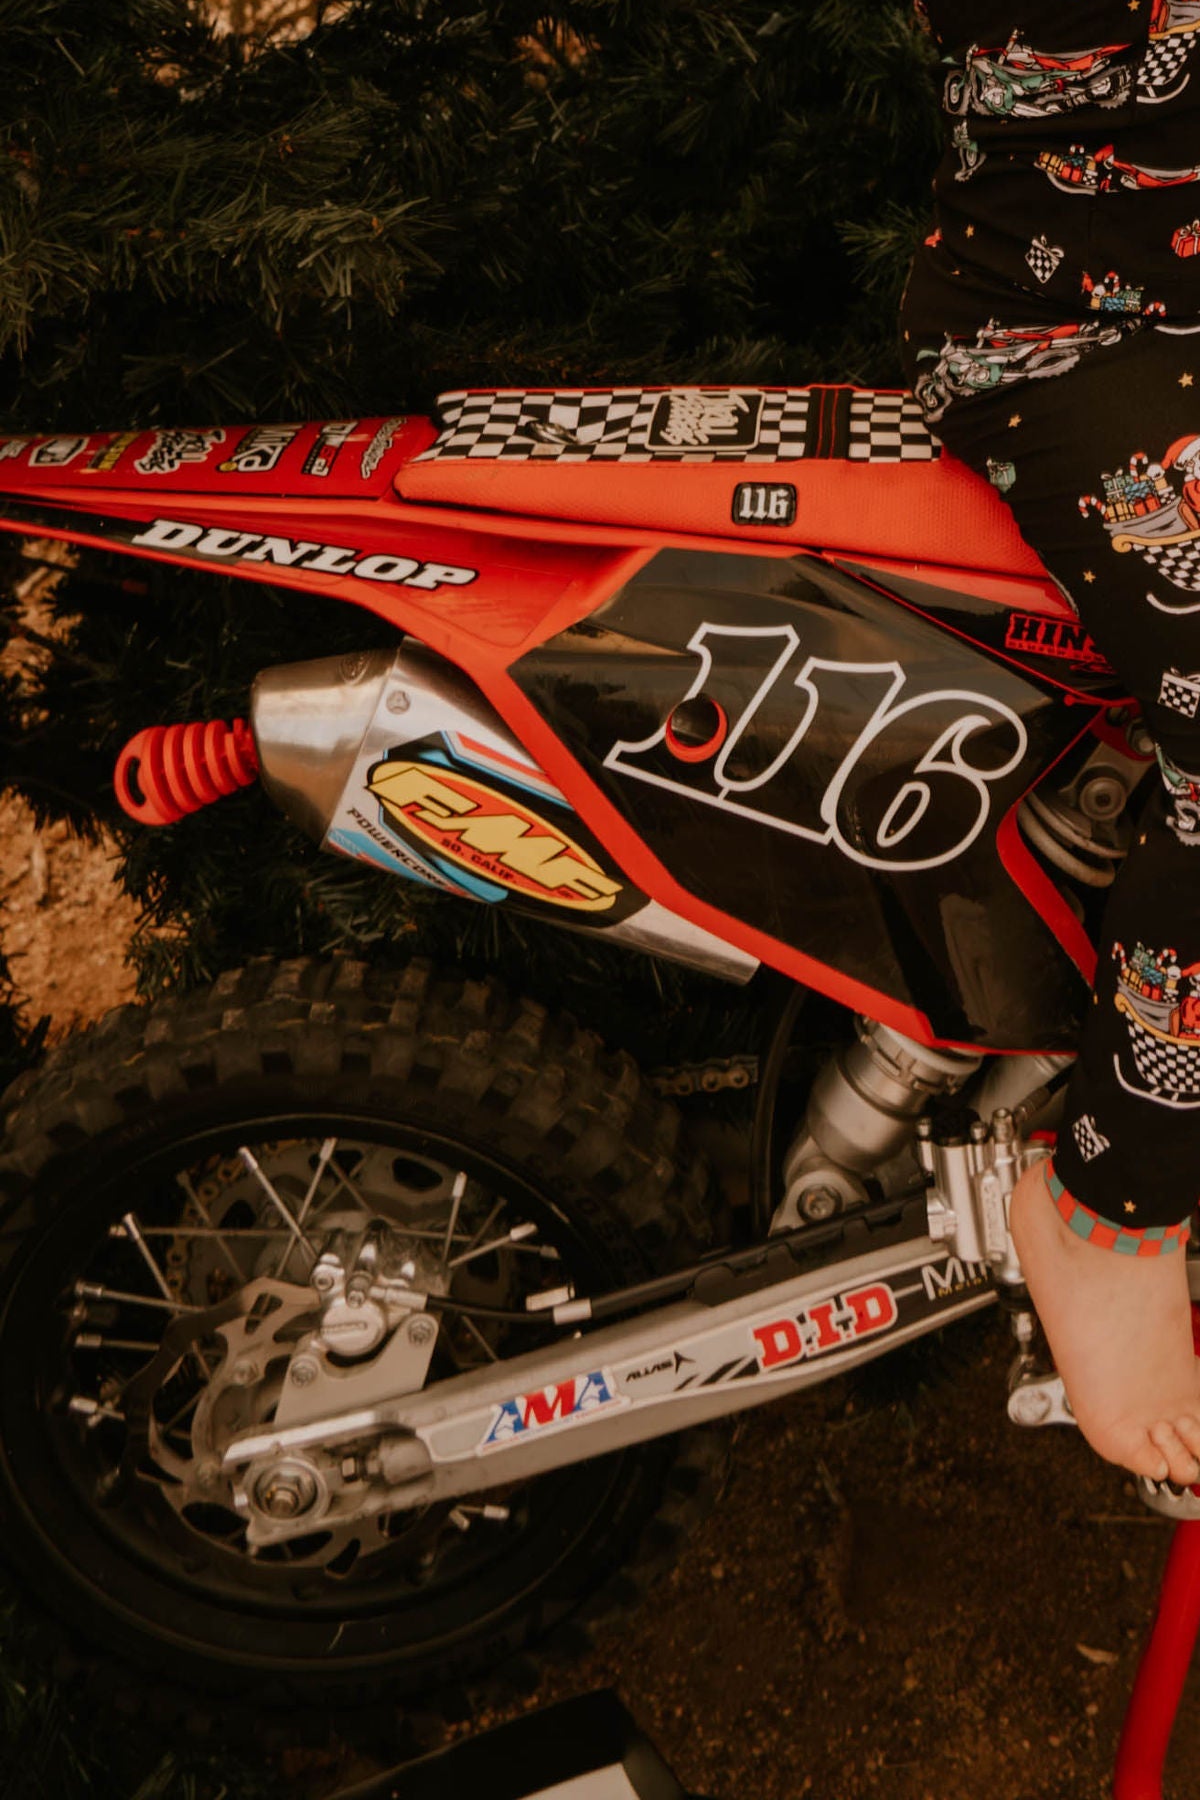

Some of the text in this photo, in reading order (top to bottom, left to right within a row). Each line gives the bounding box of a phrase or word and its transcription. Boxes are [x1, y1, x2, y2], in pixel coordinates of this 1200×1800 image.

[739, 487, 790, 520] 116
[132, 518, 479, 589] DUNLOP
[603, 622, 1027, 871] 116
[366, 767, 624, 900] FMF
[486, 1370, 612, 1443] AMA
